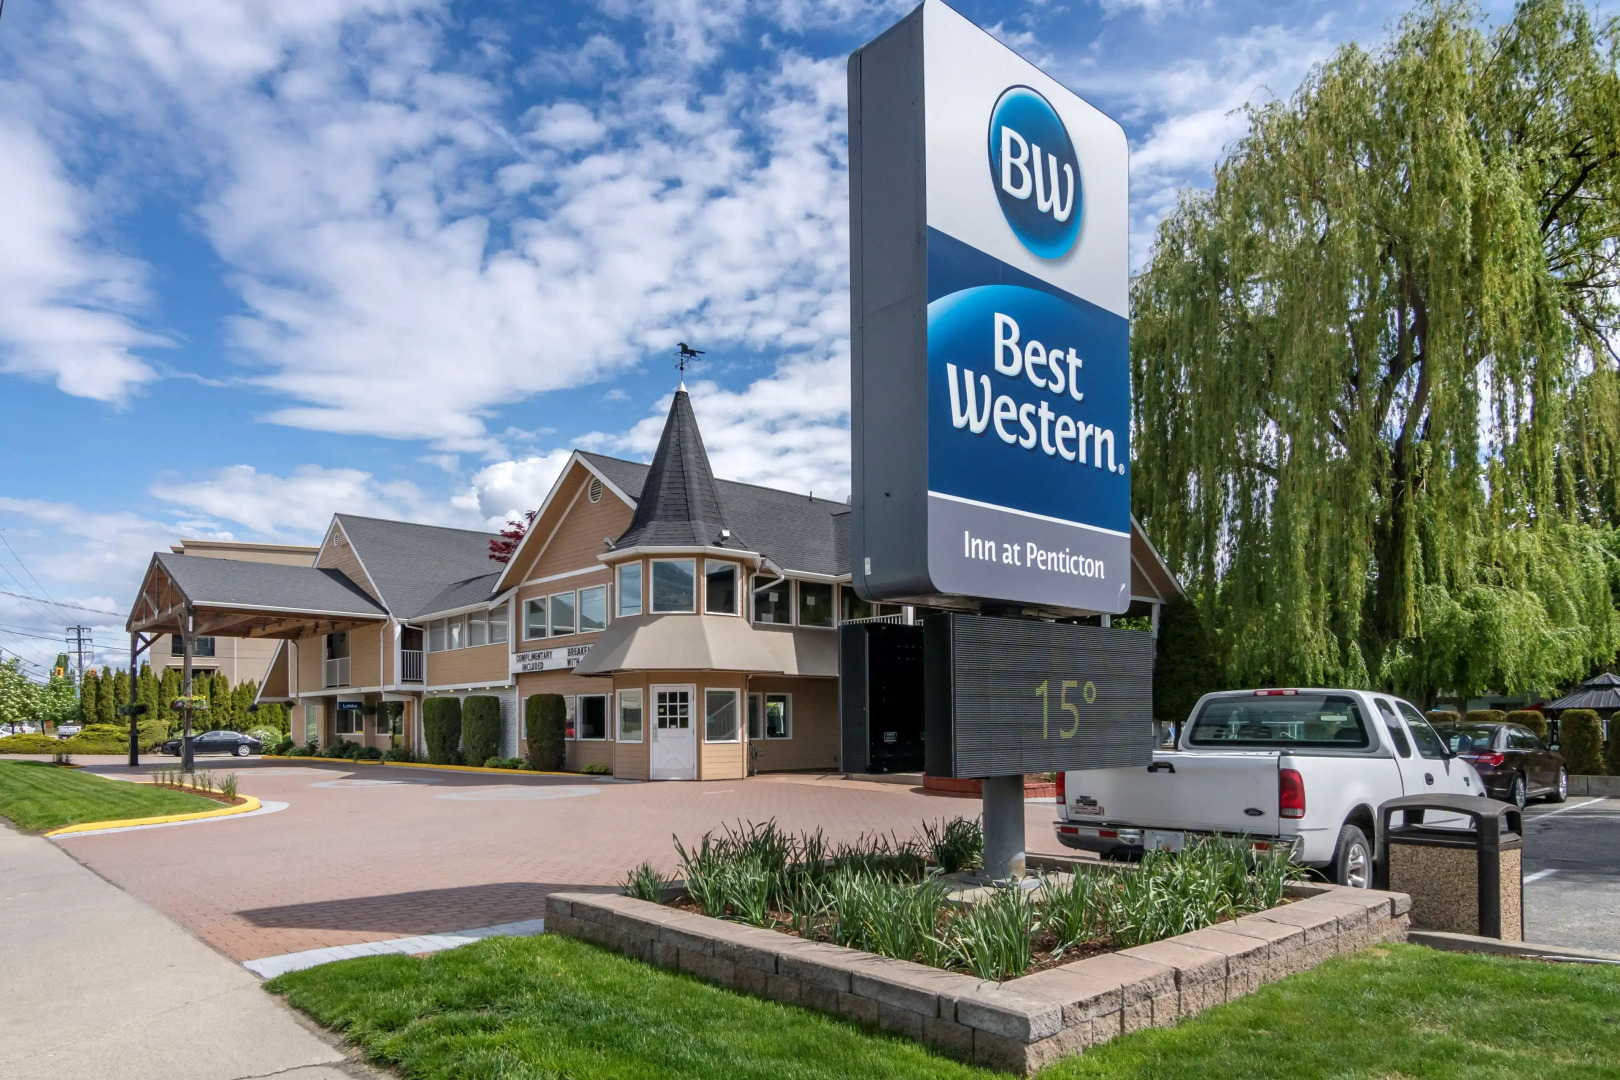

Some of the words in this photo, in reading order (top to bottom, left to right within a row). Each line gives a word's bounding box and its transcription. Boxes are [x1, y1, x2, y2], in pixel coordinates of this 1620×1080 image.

[1001, 125, 1074, 222] BW
[994, 312, 1084, 401] Best
[964, 530, 997, 562] Inn
[1002, 543, 1022, 566] at
[1026, 542, 1105, 579] Penticton
[516, 651, 552, 663] COMPLIMENTARY
[522, 662, 544, 671] INCLUDED
